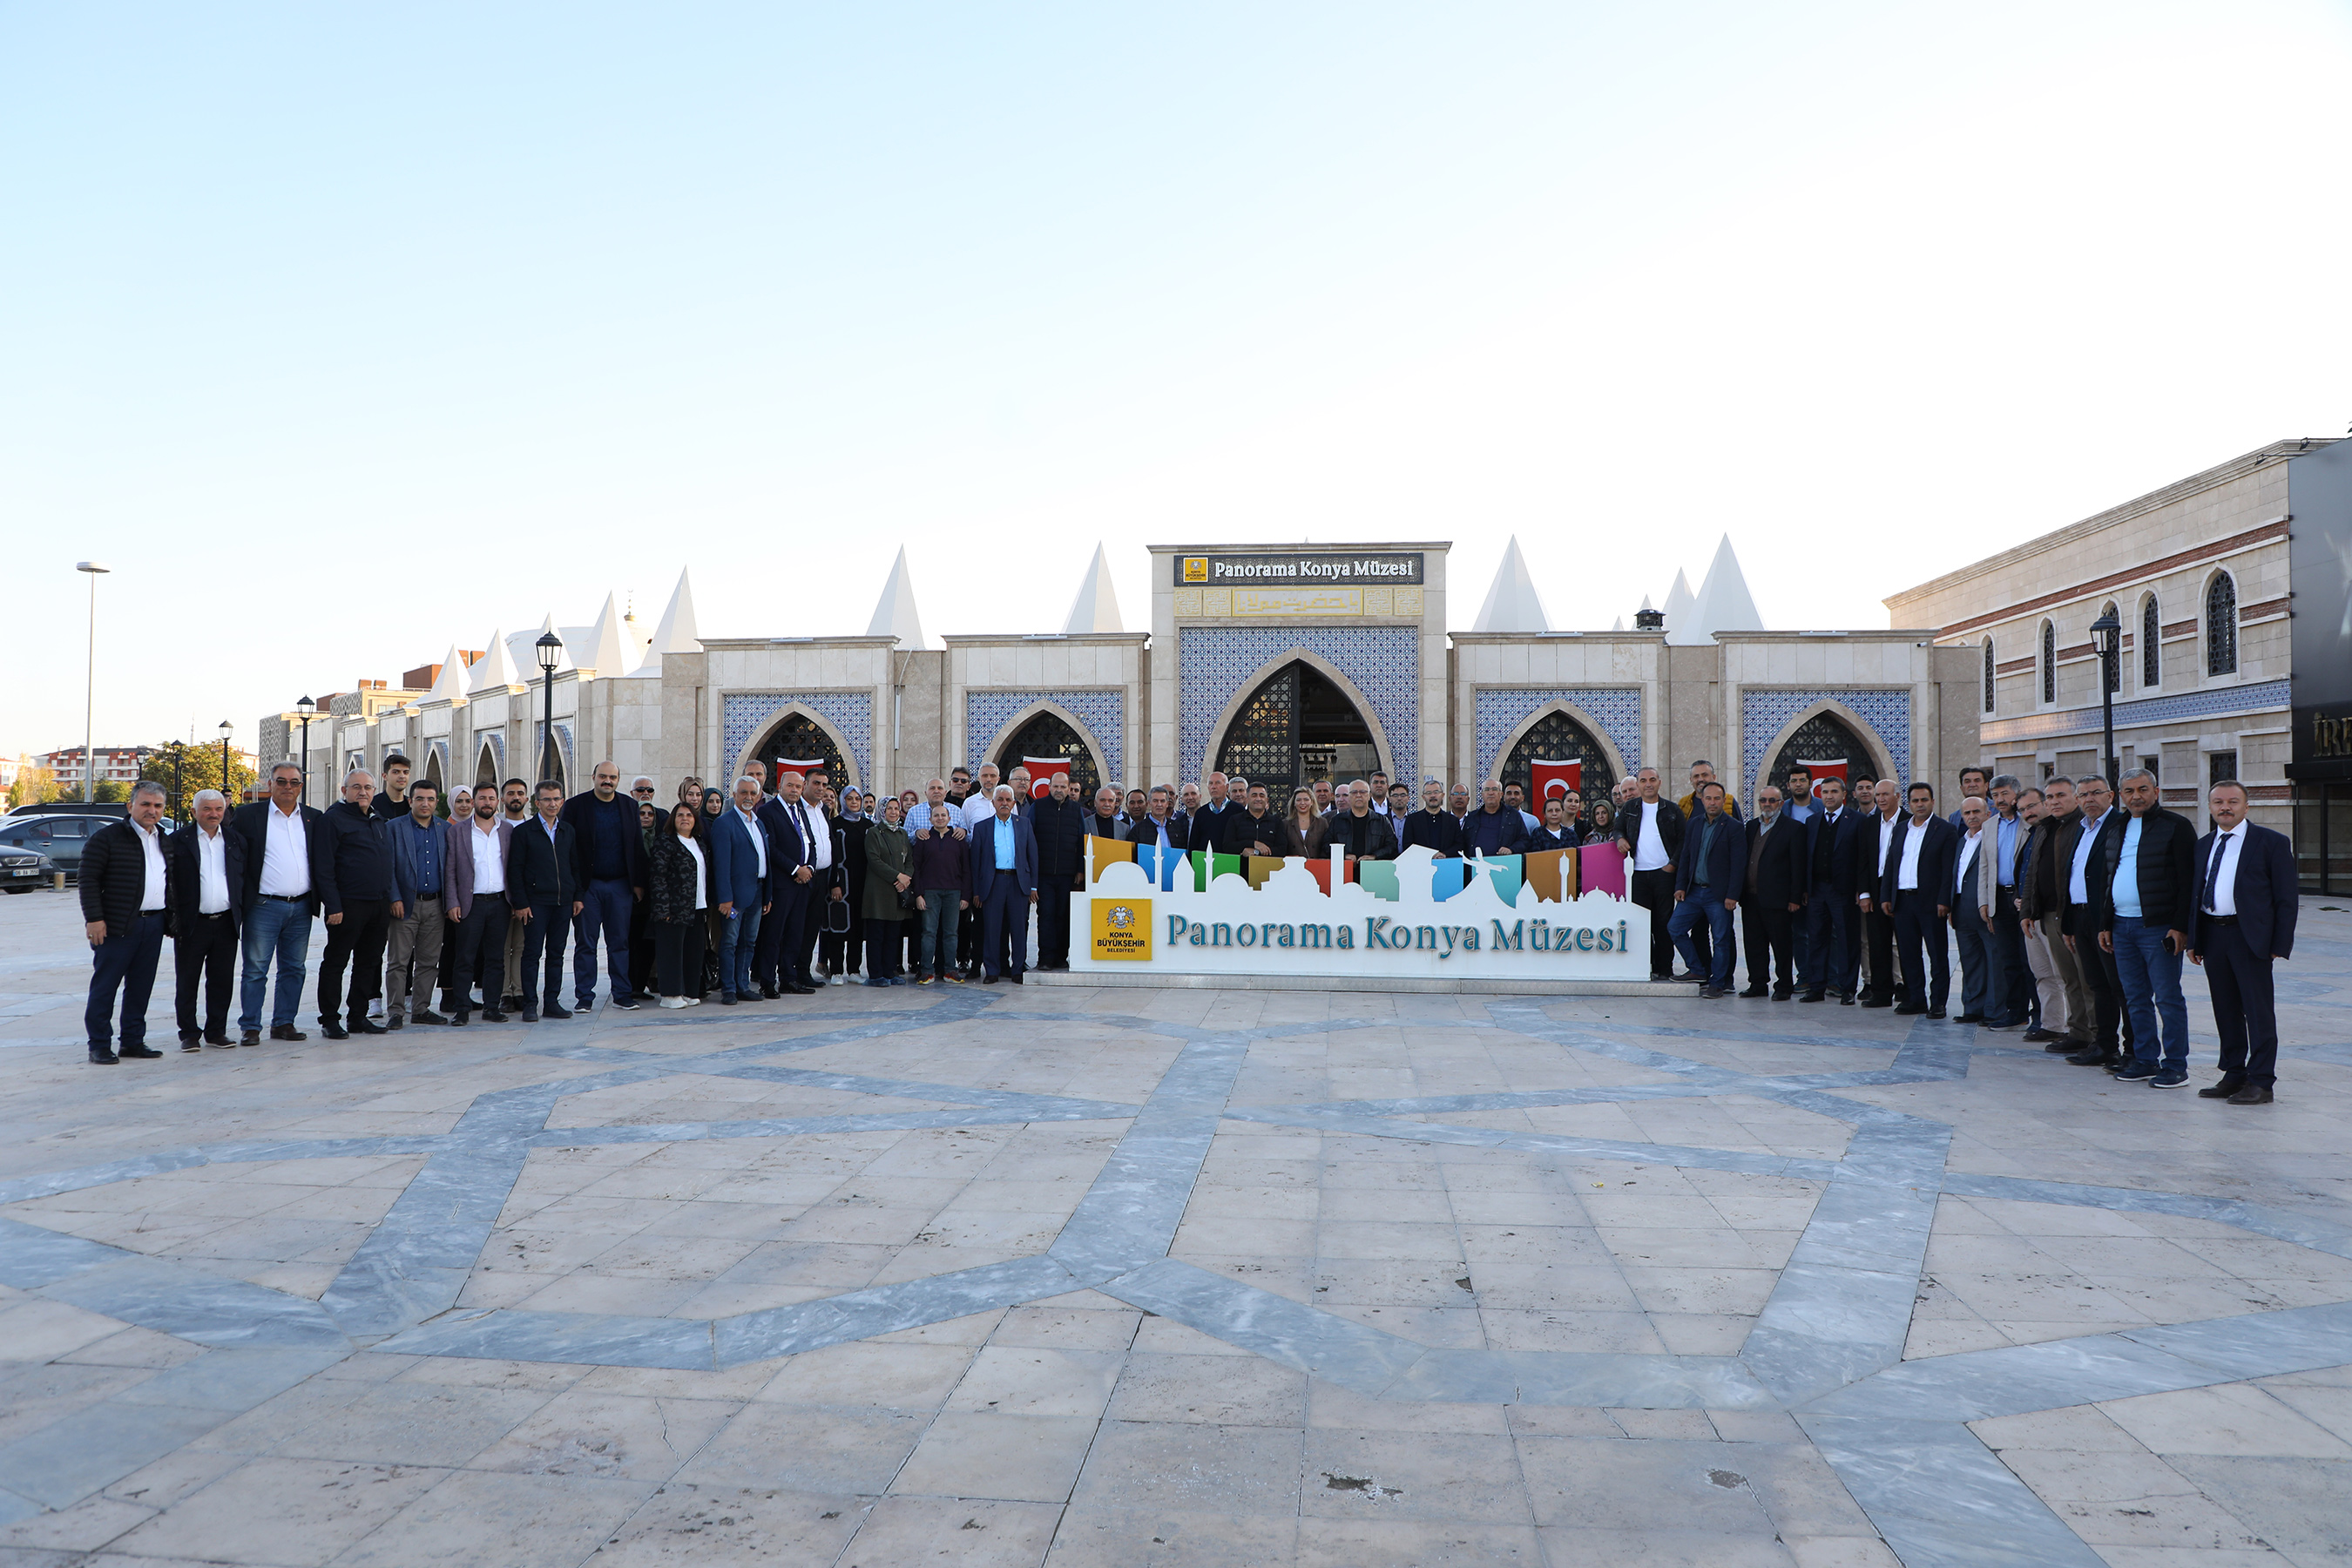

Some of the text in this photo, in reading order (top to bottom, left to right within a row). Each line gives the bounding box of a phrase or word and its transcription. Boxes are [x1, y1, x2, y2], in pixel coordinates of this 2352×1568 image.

[1214, 560, 1413, 580] Panorama Konya Müzesi
[1097, 938, 1146, 948] BÜYÜKŞEHİR
[1166, 913, 1627, 959] Panorama Konya Müzesi
